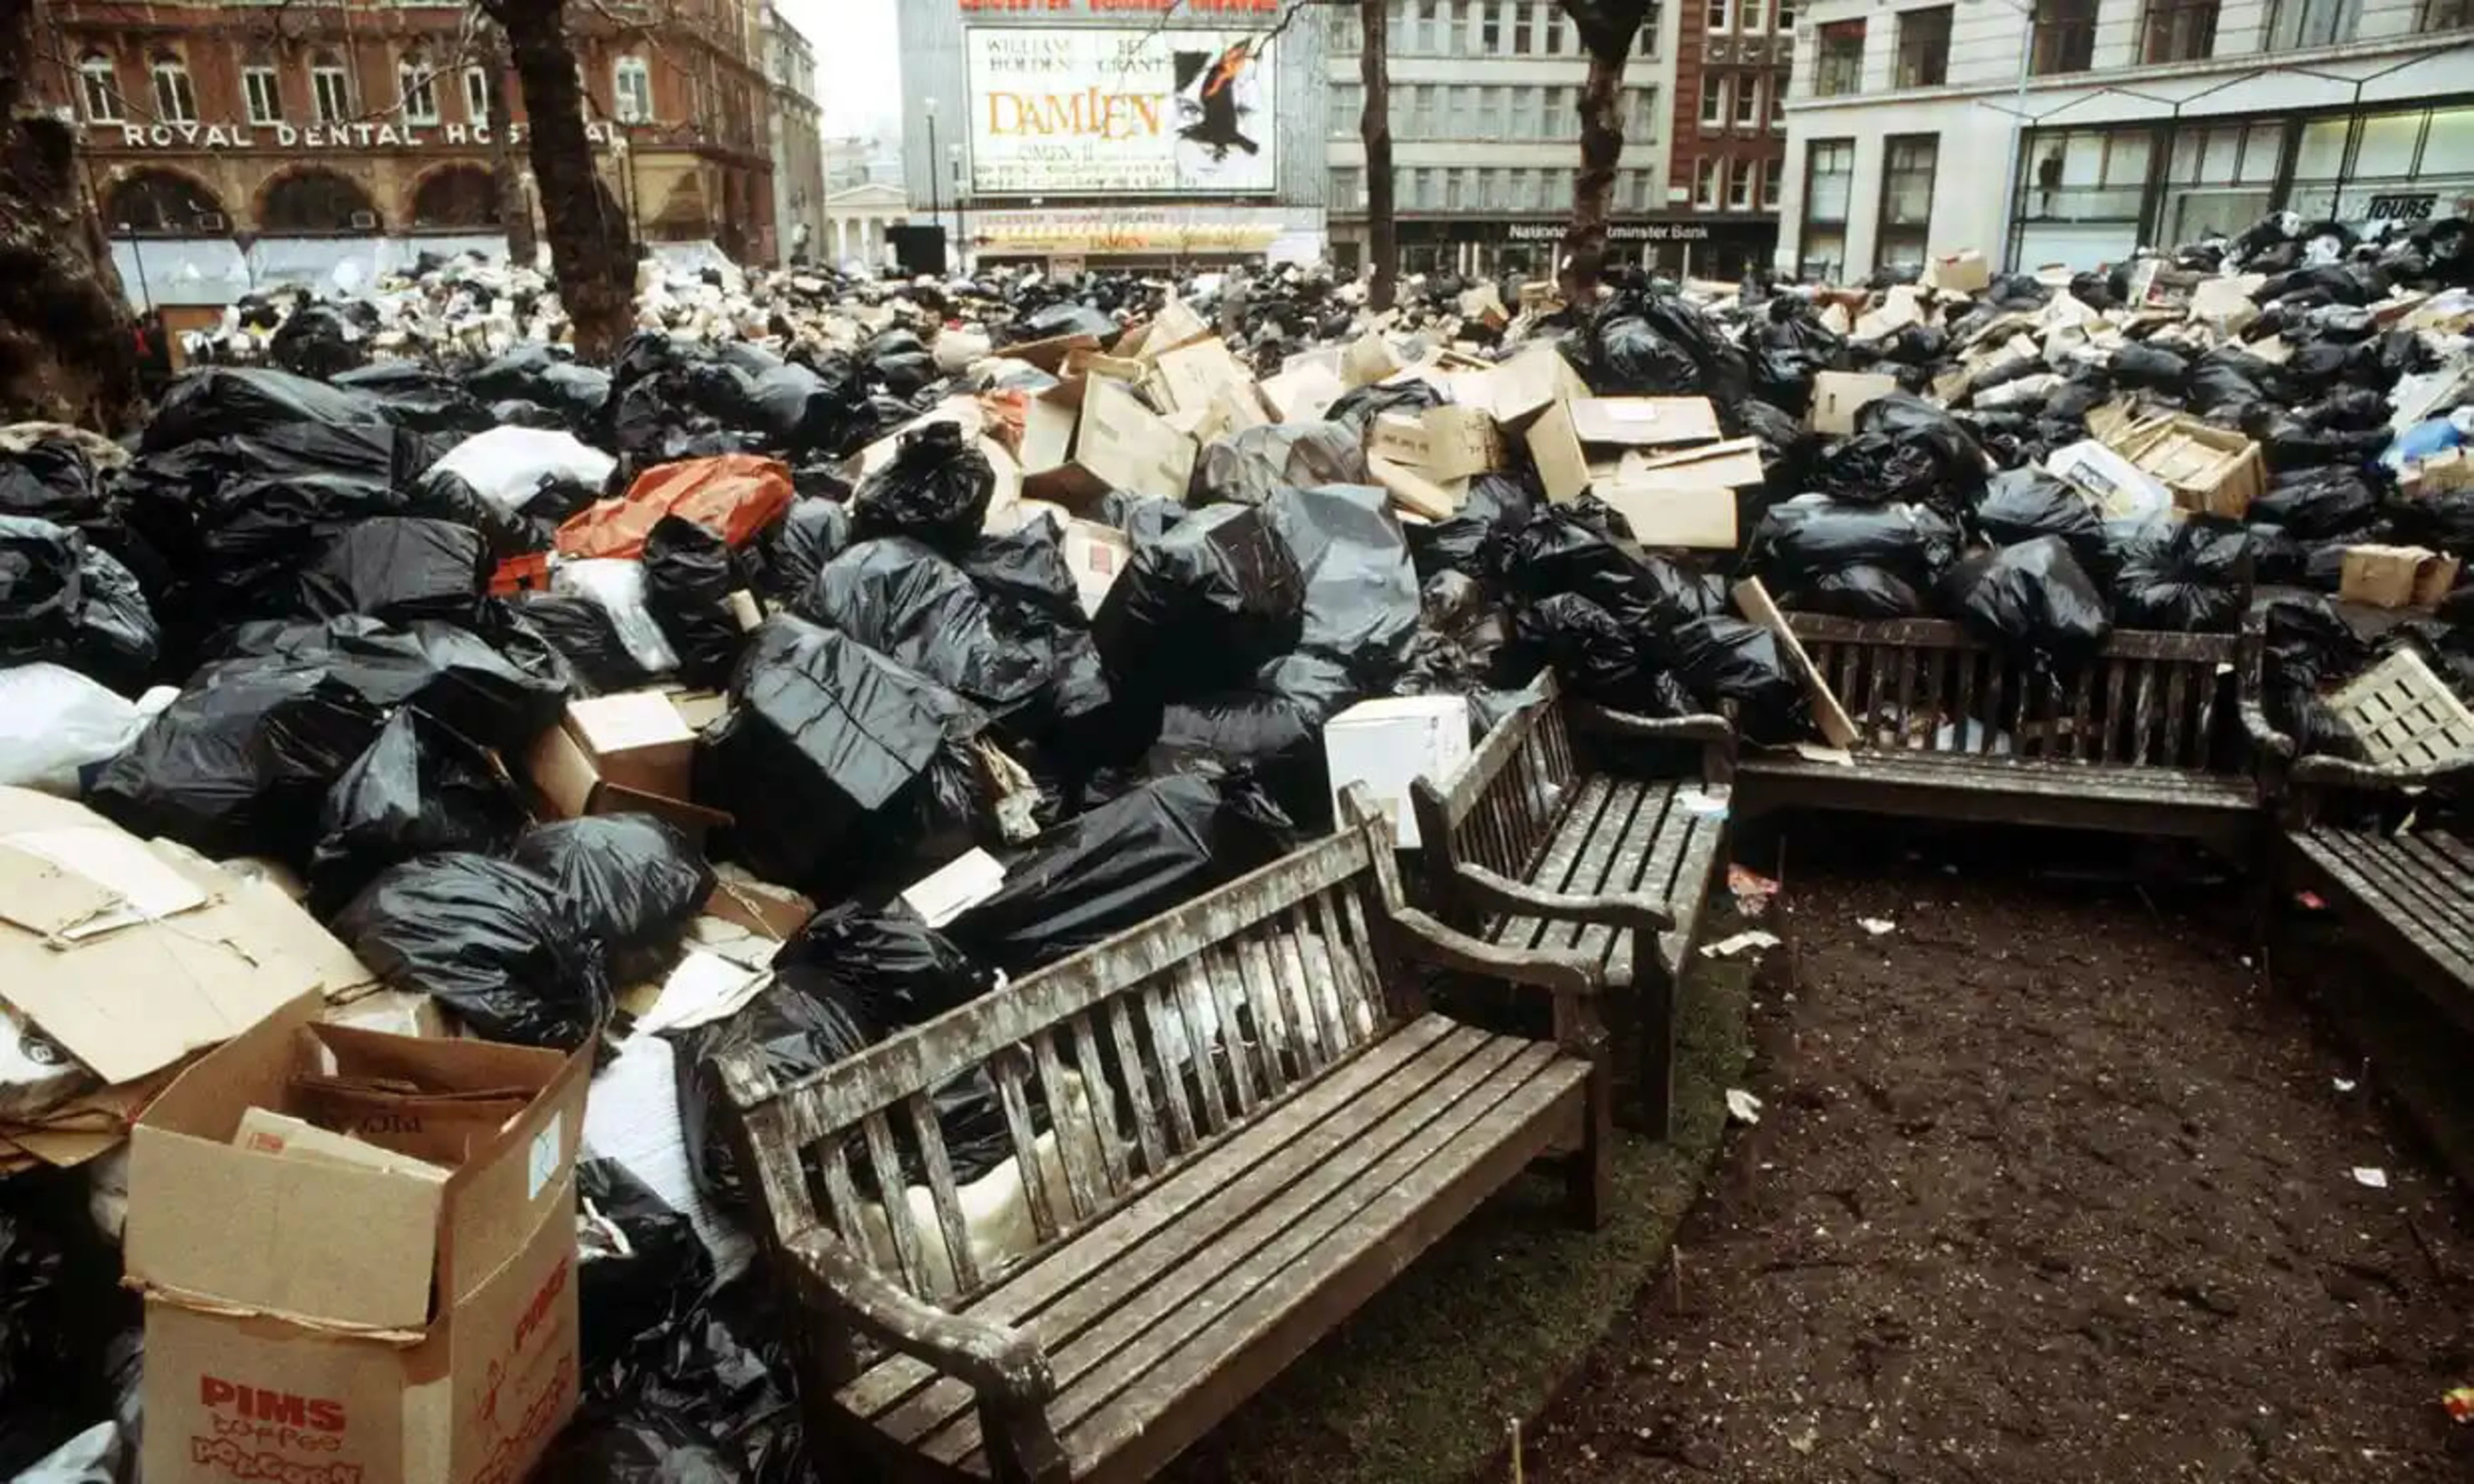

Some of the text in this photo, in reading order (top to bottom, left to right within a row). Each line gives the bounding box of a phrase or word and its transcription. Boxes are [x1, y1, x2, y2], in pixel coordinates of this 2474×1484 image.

[987, 86, 1165, 140] DAMIEN
[124, 124, 616, 146] ROYAL DENTAL HOSAL
[1671, 224, 1708, 239] Bank
[200, 1374, 347, 1432] PIMS
